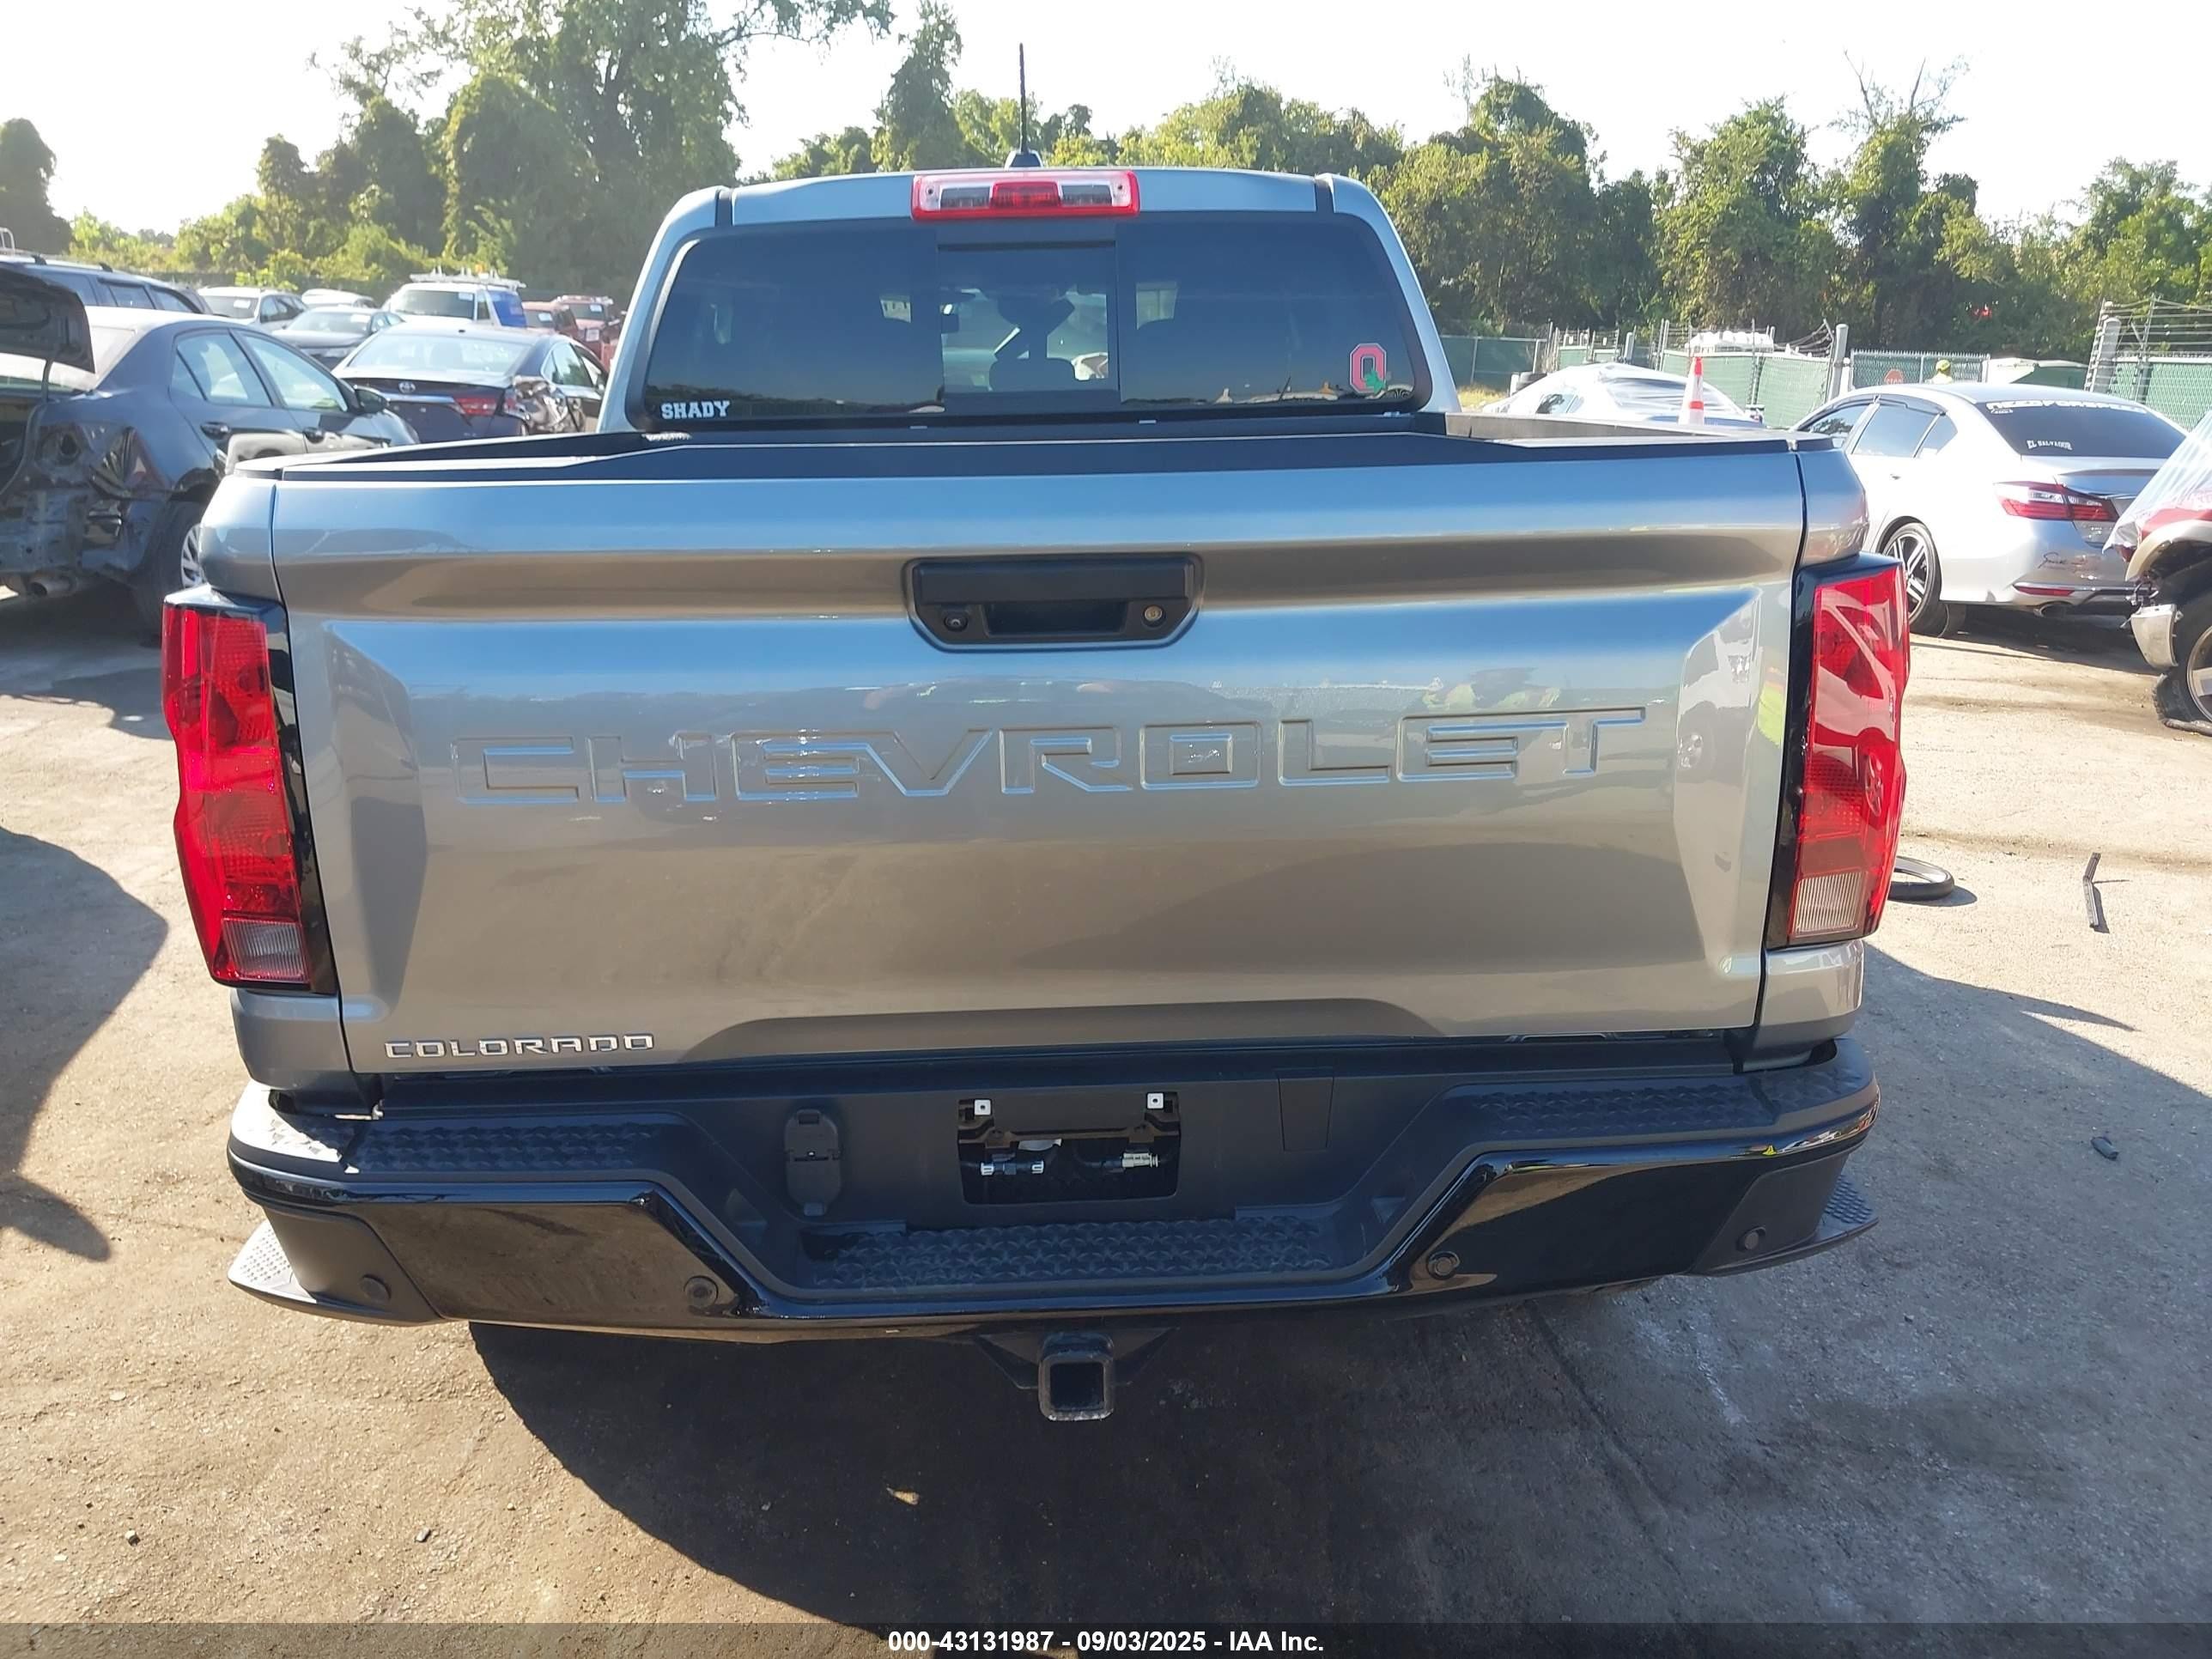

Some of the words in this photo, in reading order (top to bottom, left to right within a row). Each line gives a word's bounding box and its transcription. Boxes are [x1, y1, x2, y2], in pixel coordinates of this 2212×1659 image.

[660, 400, 730, 419] SHADY
[452, 707, 1645, 805] CHEVROLET
[384, 1032, 654, 1059] COLORADO
